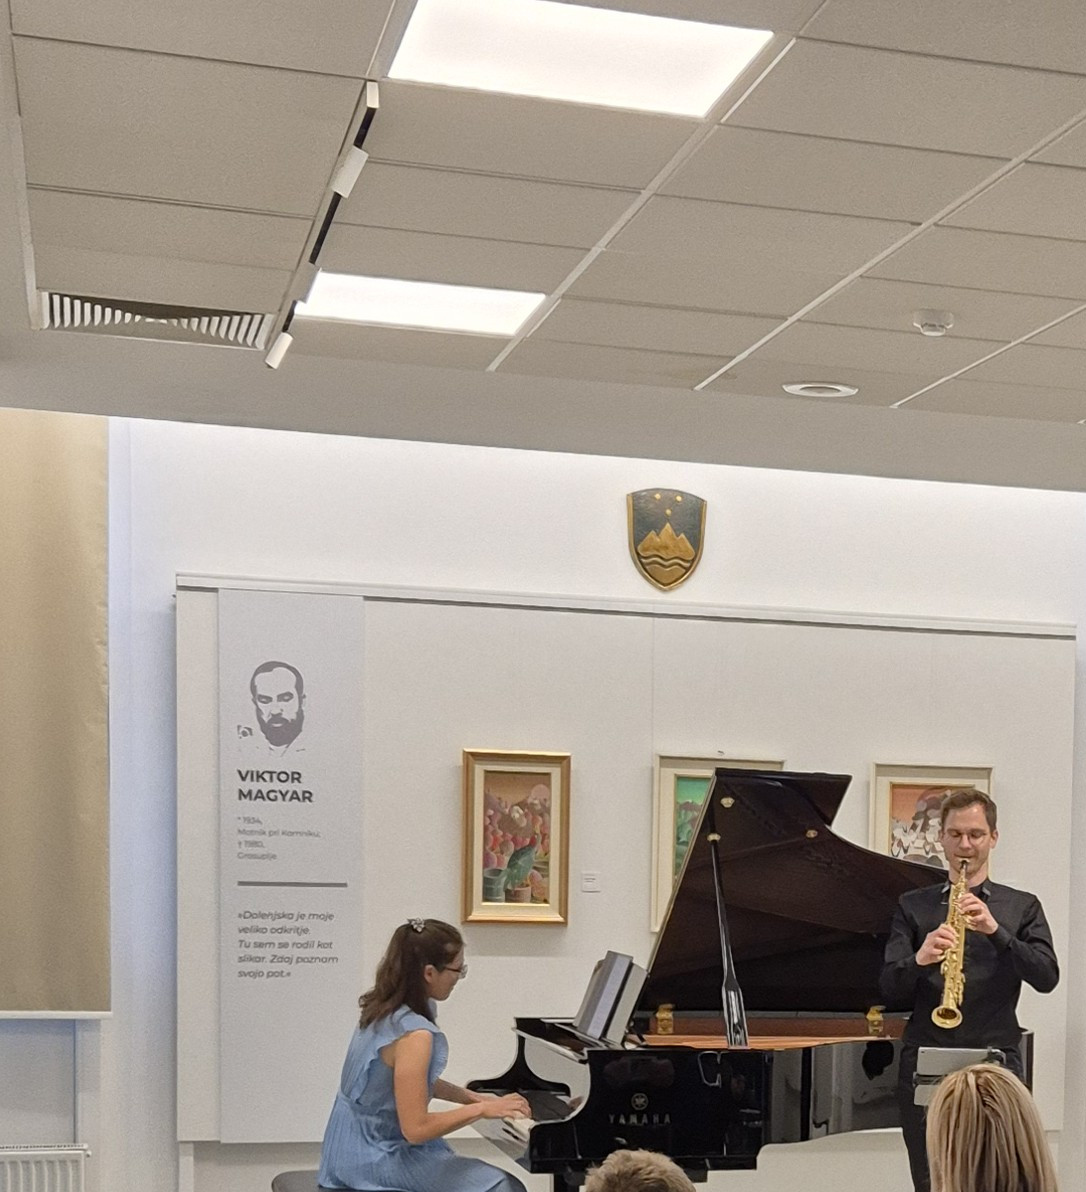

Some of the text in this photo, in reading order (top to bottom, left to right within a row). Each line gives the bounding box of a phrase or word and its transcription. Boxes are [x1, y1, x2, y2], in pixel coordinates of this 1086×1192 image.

[237, 769, 302, 784] VIKTOR
[238, 788, 313, 803] MAGYAR
[295, 912, 306, 921] je
[308, 912, 335, 922] moje
[238, 925, 311, 936] veliko odkritje.
[238, 939, 250, 948] Tu
[253, 941, 275, 949] sem
[292, 940, 315, 949] rodil
[317, 940, 333, 949] kot
[238, 954, 339, 965] slikar. Zdaj poznam
[237, 970, 265, 979] svojo
[608, 1113, 671, 1125] YAMAHA
